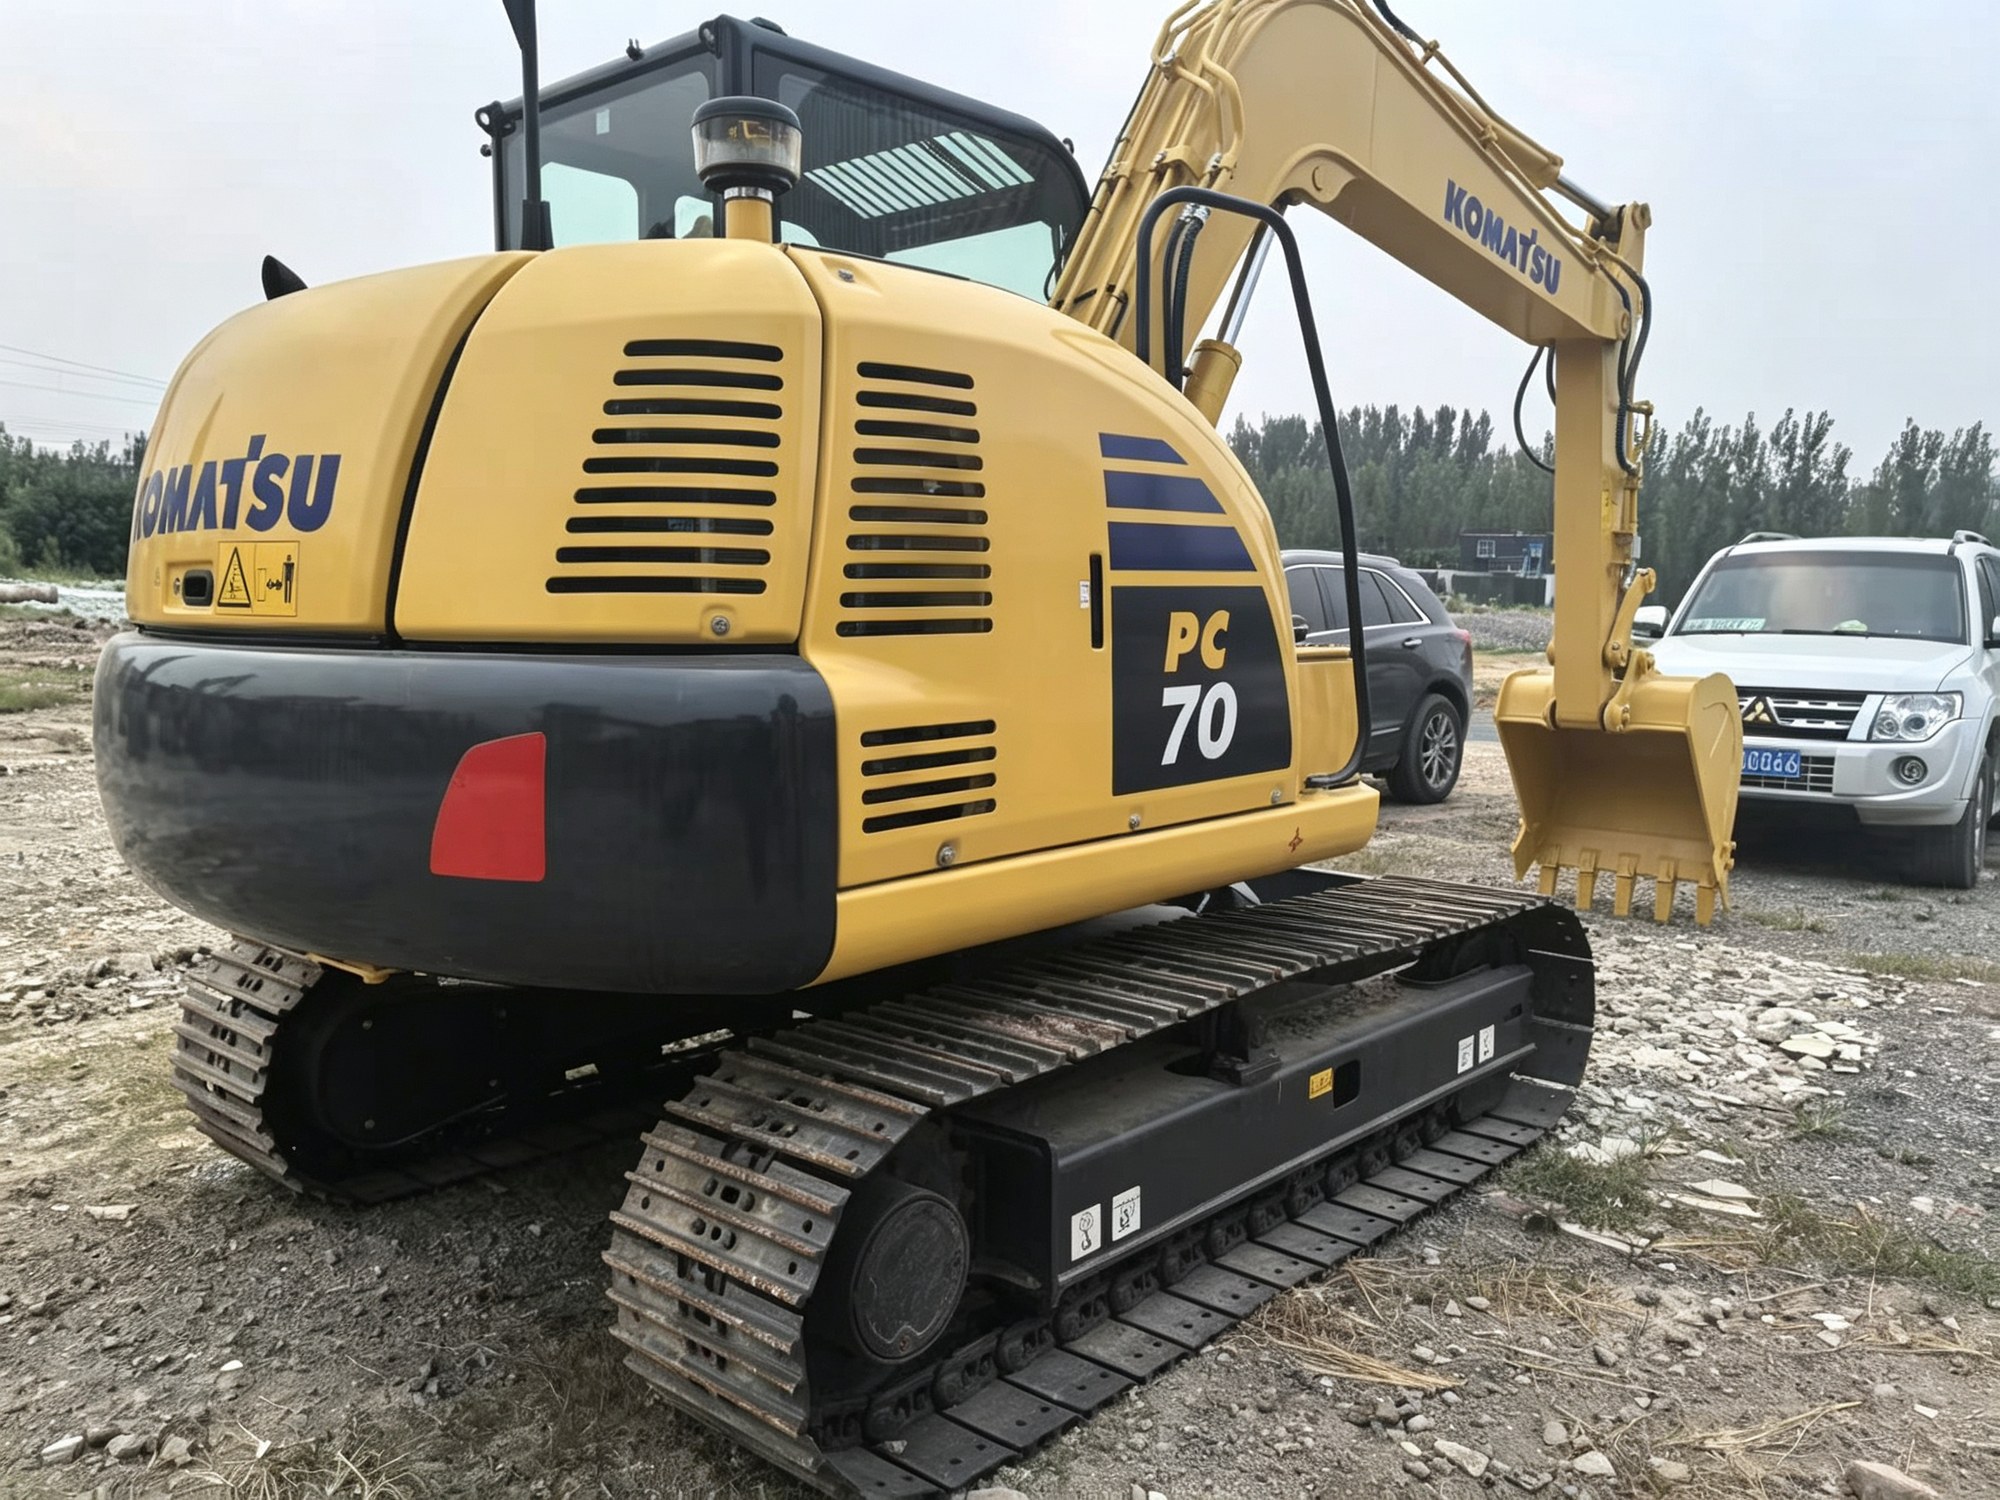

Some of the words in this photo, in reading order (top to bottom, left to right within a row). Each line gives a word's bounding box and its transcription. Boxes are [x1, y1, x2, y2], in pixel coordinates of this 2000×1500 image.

[1444, 178, 1561, 295] KOMATSU
[1164, 610, 1230, 672] PC
[1161, 682, 1238, 766] 70
